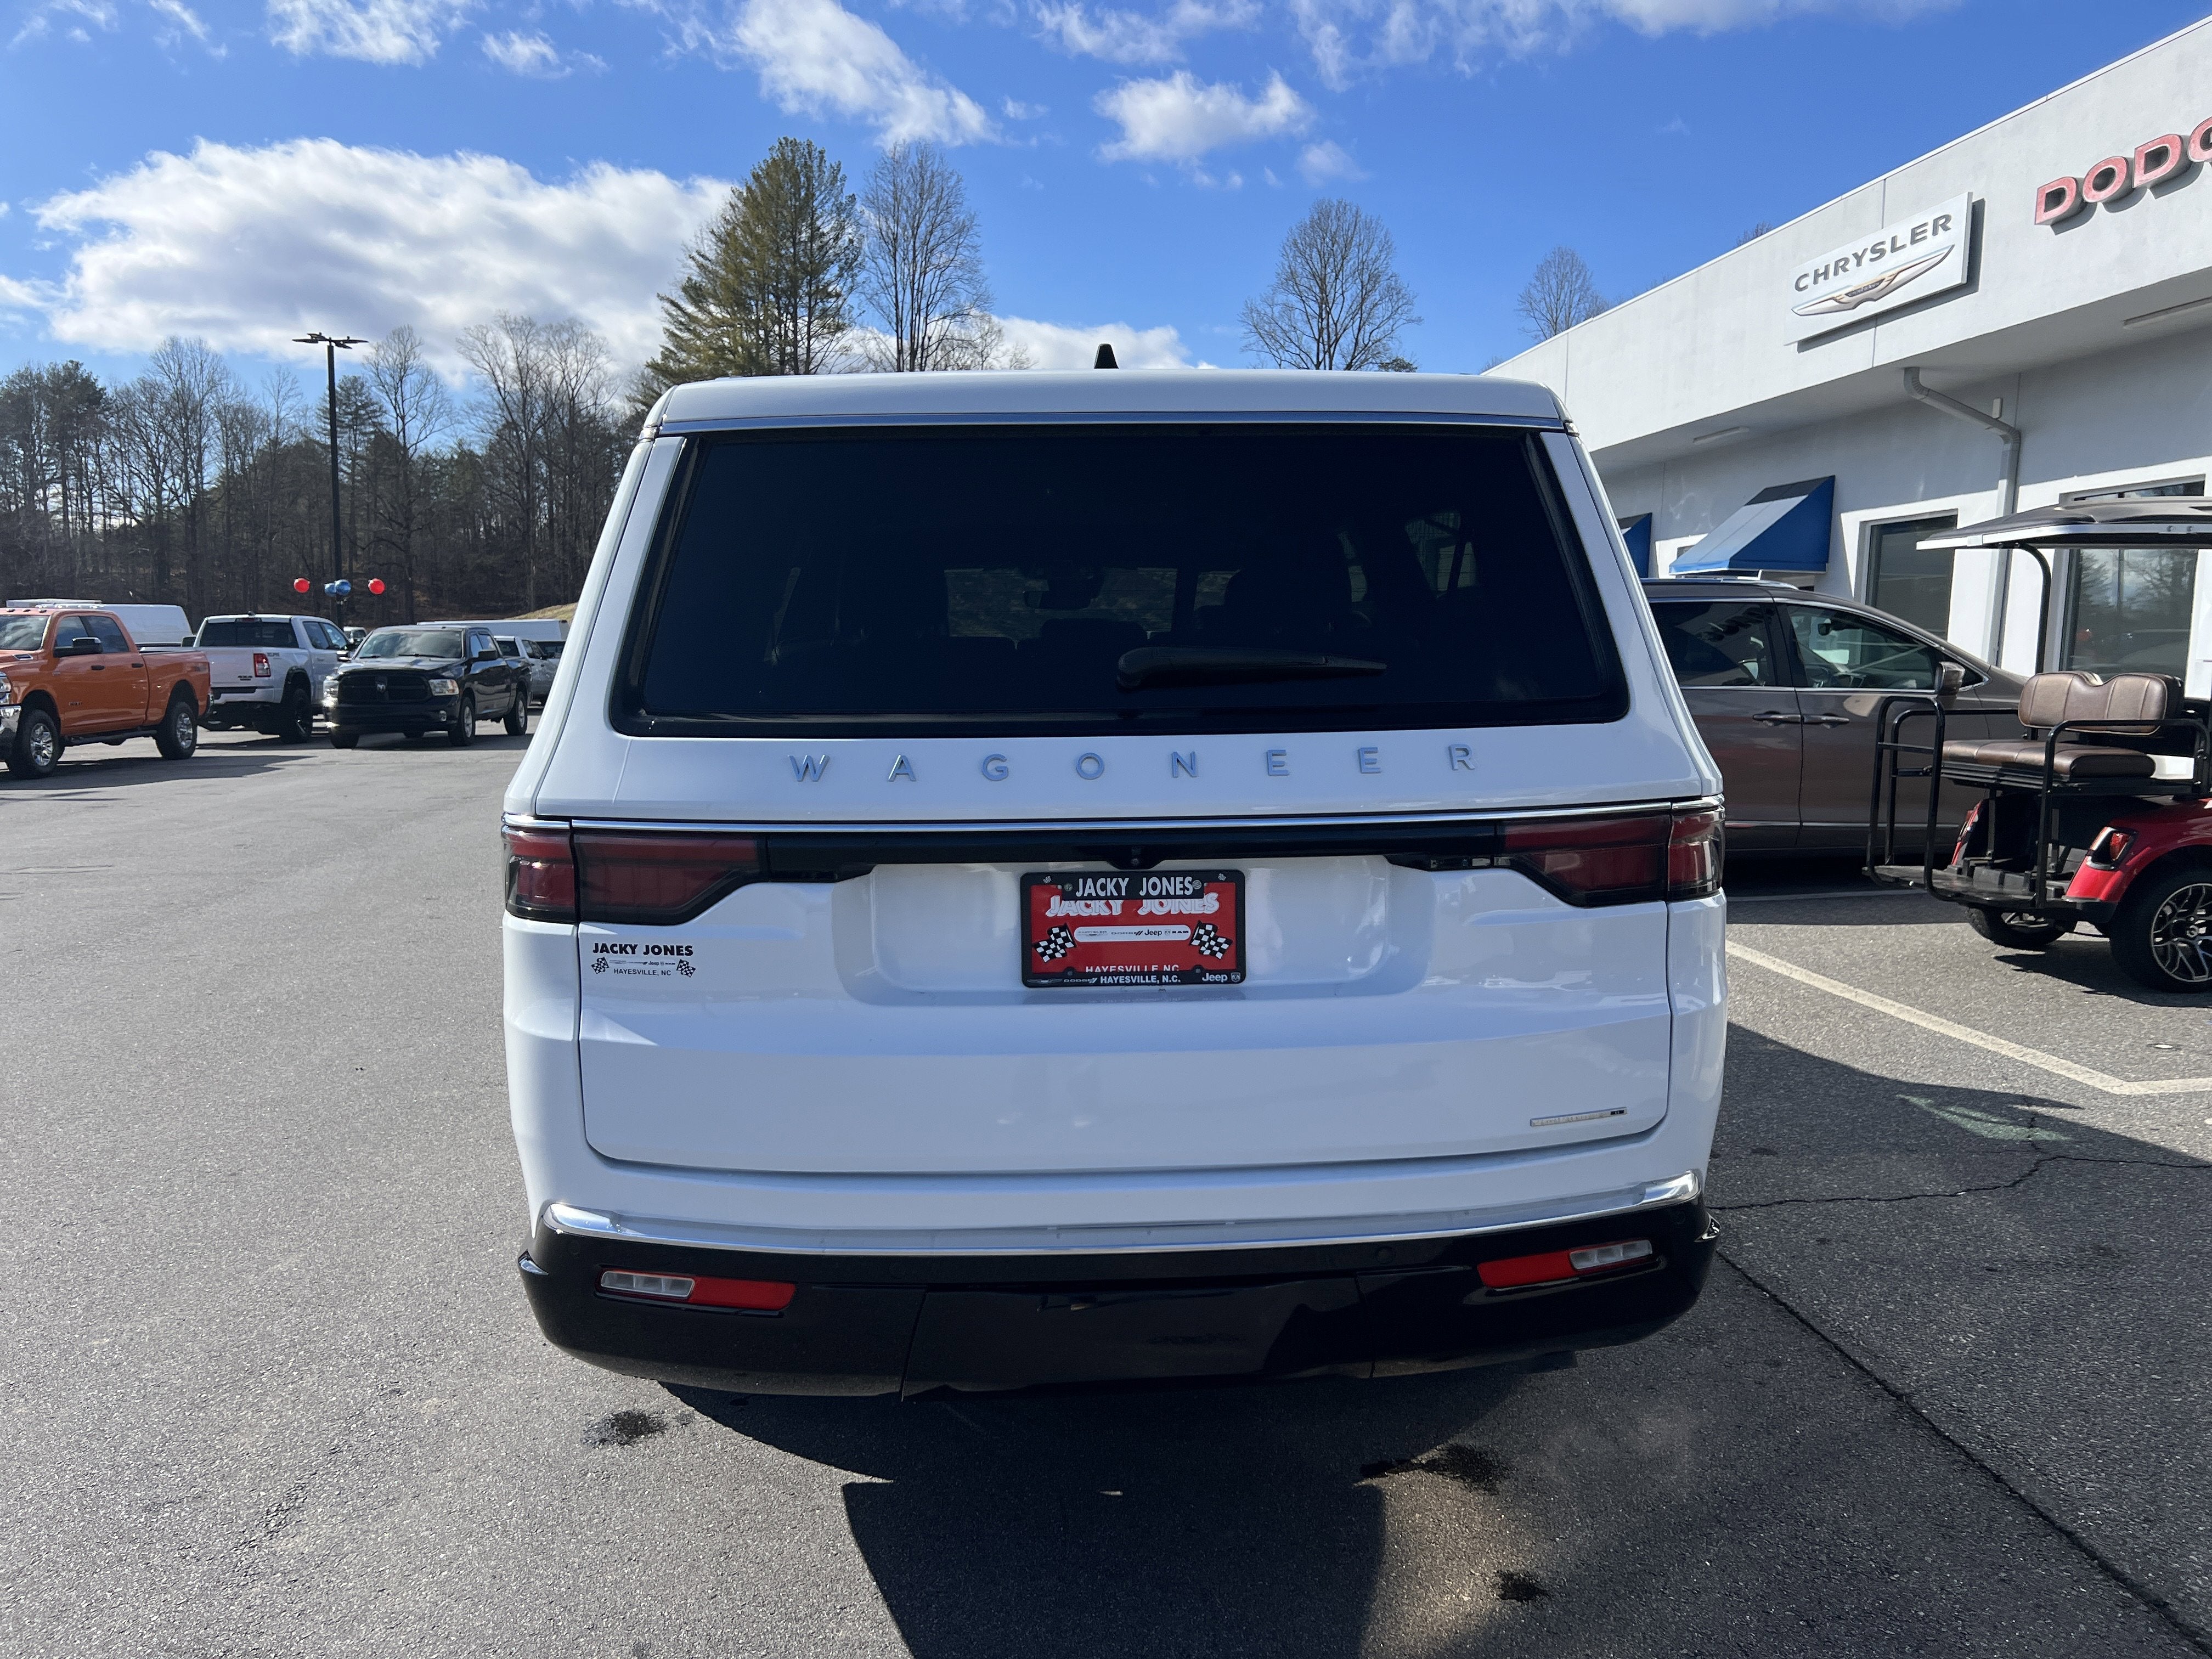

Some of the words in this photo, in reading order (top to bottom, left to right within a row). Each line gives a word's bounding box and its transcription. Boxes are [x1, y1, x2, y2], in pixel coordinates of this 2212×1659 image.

[1795, 214, 1952, 292] CHRYSLER
[788, 743, 1475, 782] WAGONEER
[1076, 877, 1129, 897] JACKY
[1139, 877, 1193, 896] JONES
[1045, 895, 1125, 917] JACKY
[1137, 892, 1220, 915] JONES
[592, 943, 638, 955] JACKY
[643, 945, 693, 956] JONES
[1100, 975, 1160, 984] HAYESVILLE,
[1162, 974, 1181, 983] N.C.
[1202, 973, 1228, 983] Jeep
